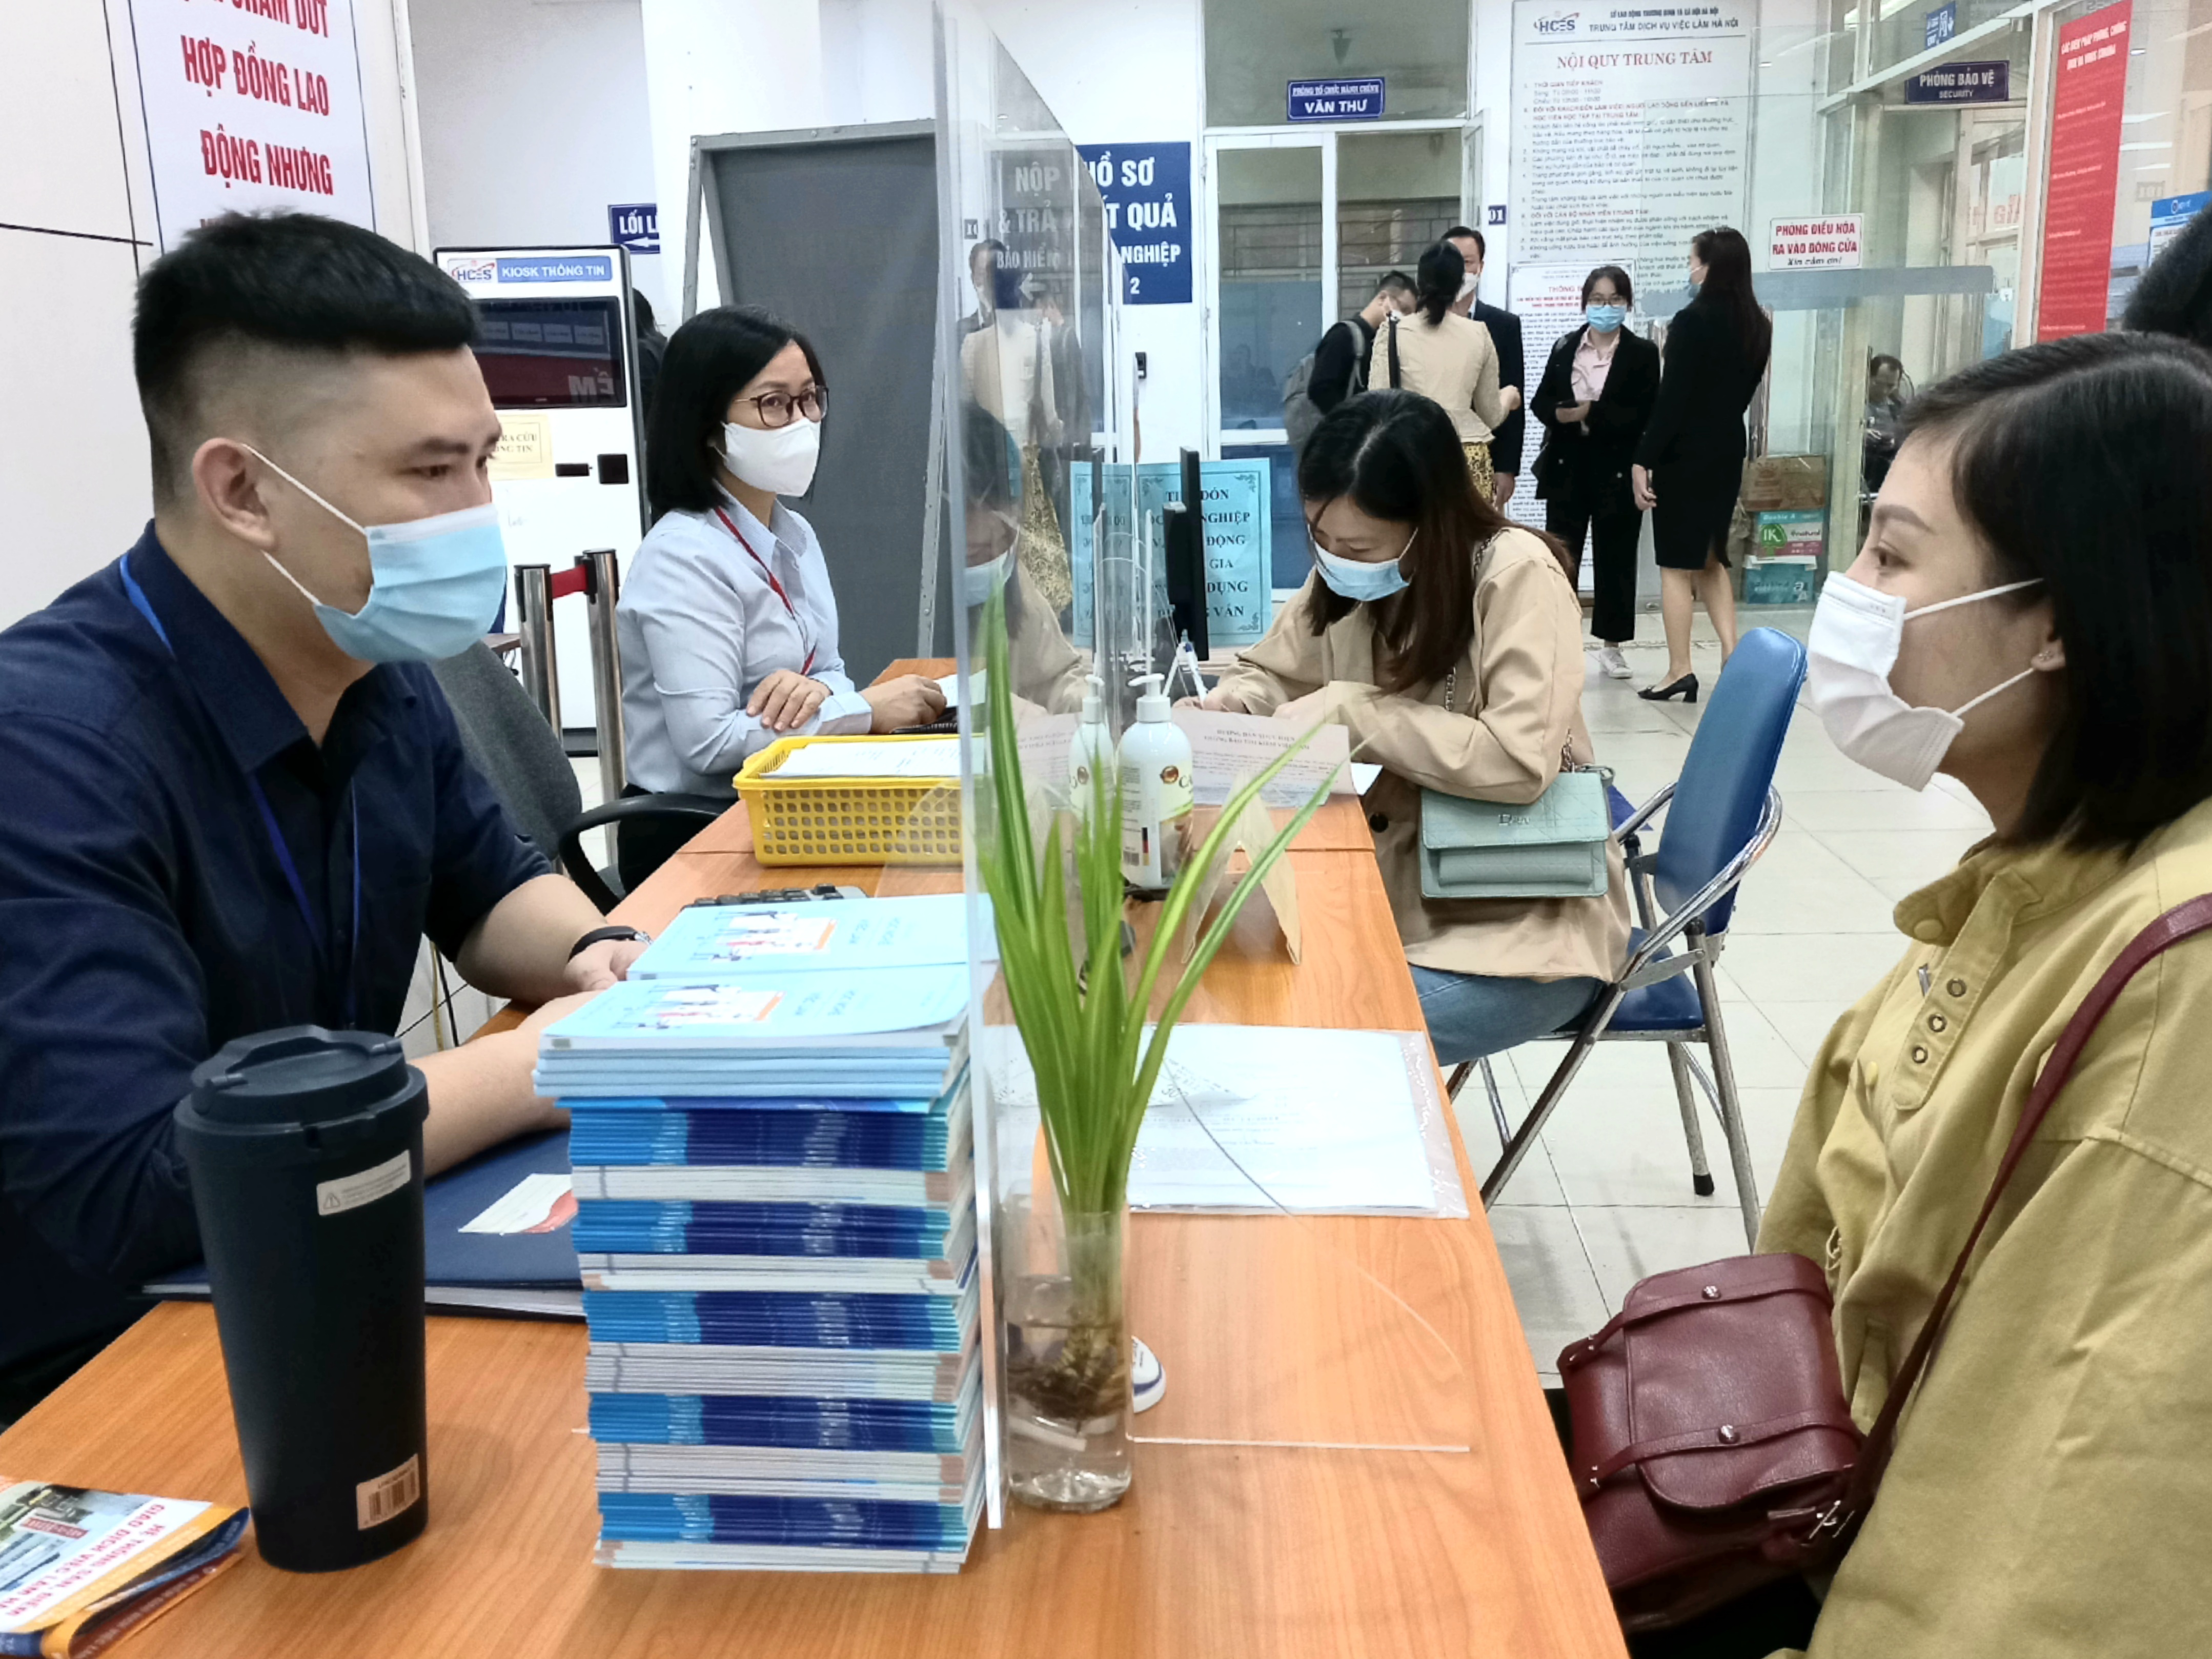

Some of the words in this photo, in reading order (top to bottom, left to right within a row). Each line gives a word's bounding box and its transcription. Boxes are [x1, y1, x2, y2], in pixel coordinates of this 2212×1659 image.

[1557, 52, 1584, 71] NỘI
[1588, 54, 1620, 70] QUY
[1623, 52, 1677, 66] TRUNG
[1679, 48, 1713, 64] TÂM
[180, 34, 227, 97] HỢP
[232, 39, 292, 107] ĐỒNG
[293, 68, 329, 116] LAO
[1919, 71, 1956, 87] PHÒNG
[1957, 67, 1979, 86] BẢO
[1981, 69, 1995, 87] VỆ
[1304, 99, 1335, 114] VĂN
[1338, 98, 1368, 112] THƯ
[200, 123, 261, 188] ĐỘNG
[265, 143, 333, 195] NHƯNG
[1016, 161, 1060, 196] NỘP
[1121, 157, 1155, 187] SƠ
[619, 209, 643, 234] LỐI
[1015, 199, 1057, 233] TRẢ
[1128, 193, 1178, 231] QUẢ
[1775, 222, 1809, 236] PHÒNG
[1835, 220, 1855, 234] HÒA
[997, 245, 1020, 269] BẢO
[1121, 241, 1181, 267] NGHIỆP
[1772, 244, 1785, 255] RA
[1788, 240, 1806, 254] VÀO
[1808, 240, 1835, 253] ĐÓNG
[1837, 237, 1858, 253] CỬA
[502, 267, 539, 278] KIOSK
[541, 263, 583, 277] THÔNG
[585, 265, 605, 276] TIN
[1130, 277, 1140, 294] 2
